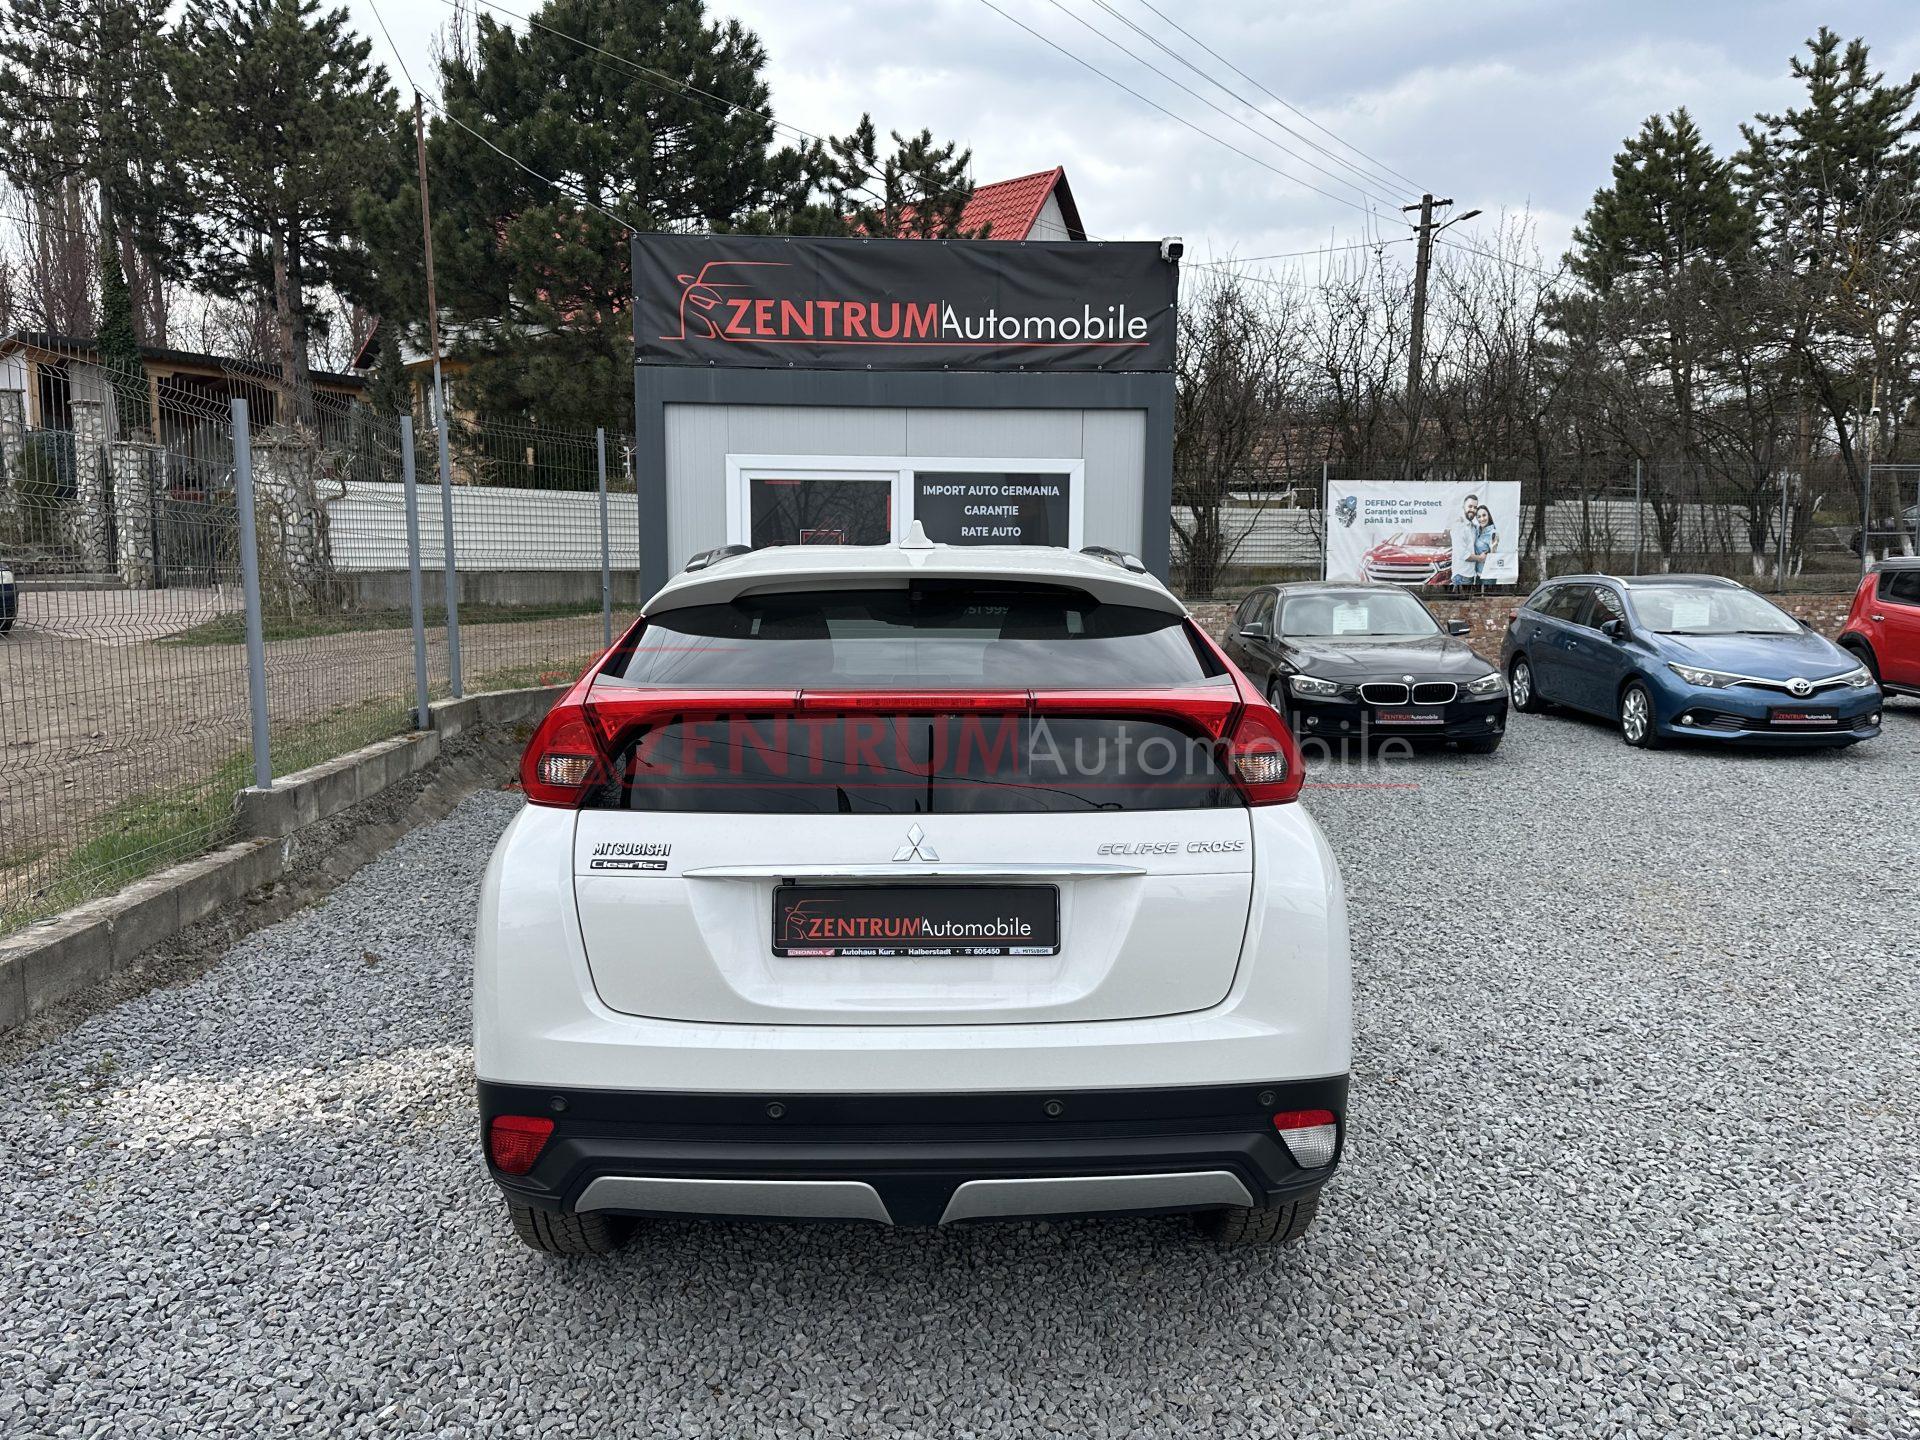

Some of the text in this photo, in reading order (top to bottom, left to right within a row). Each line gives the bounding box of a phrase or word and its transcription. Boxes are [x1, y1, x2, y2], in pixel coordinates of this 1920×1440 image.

[923, 485, 1060, 496] IMPORT AUTO GERMANIA
[1365, 499, 1442, 507] DEFEND Car Protect
[1400, 516, 1413, 524] ani
[961, 526, 1022, 537] RATE AUTO
[592, 842, 671, 857] MITSUBISHI
[1097, 840, 1244, 856] ECLIPSE CROSS
[591, 860, 666, 870] ClearTec
[841, 948, 1001, 957] Autohaus Kurz Halberstadt 605450
